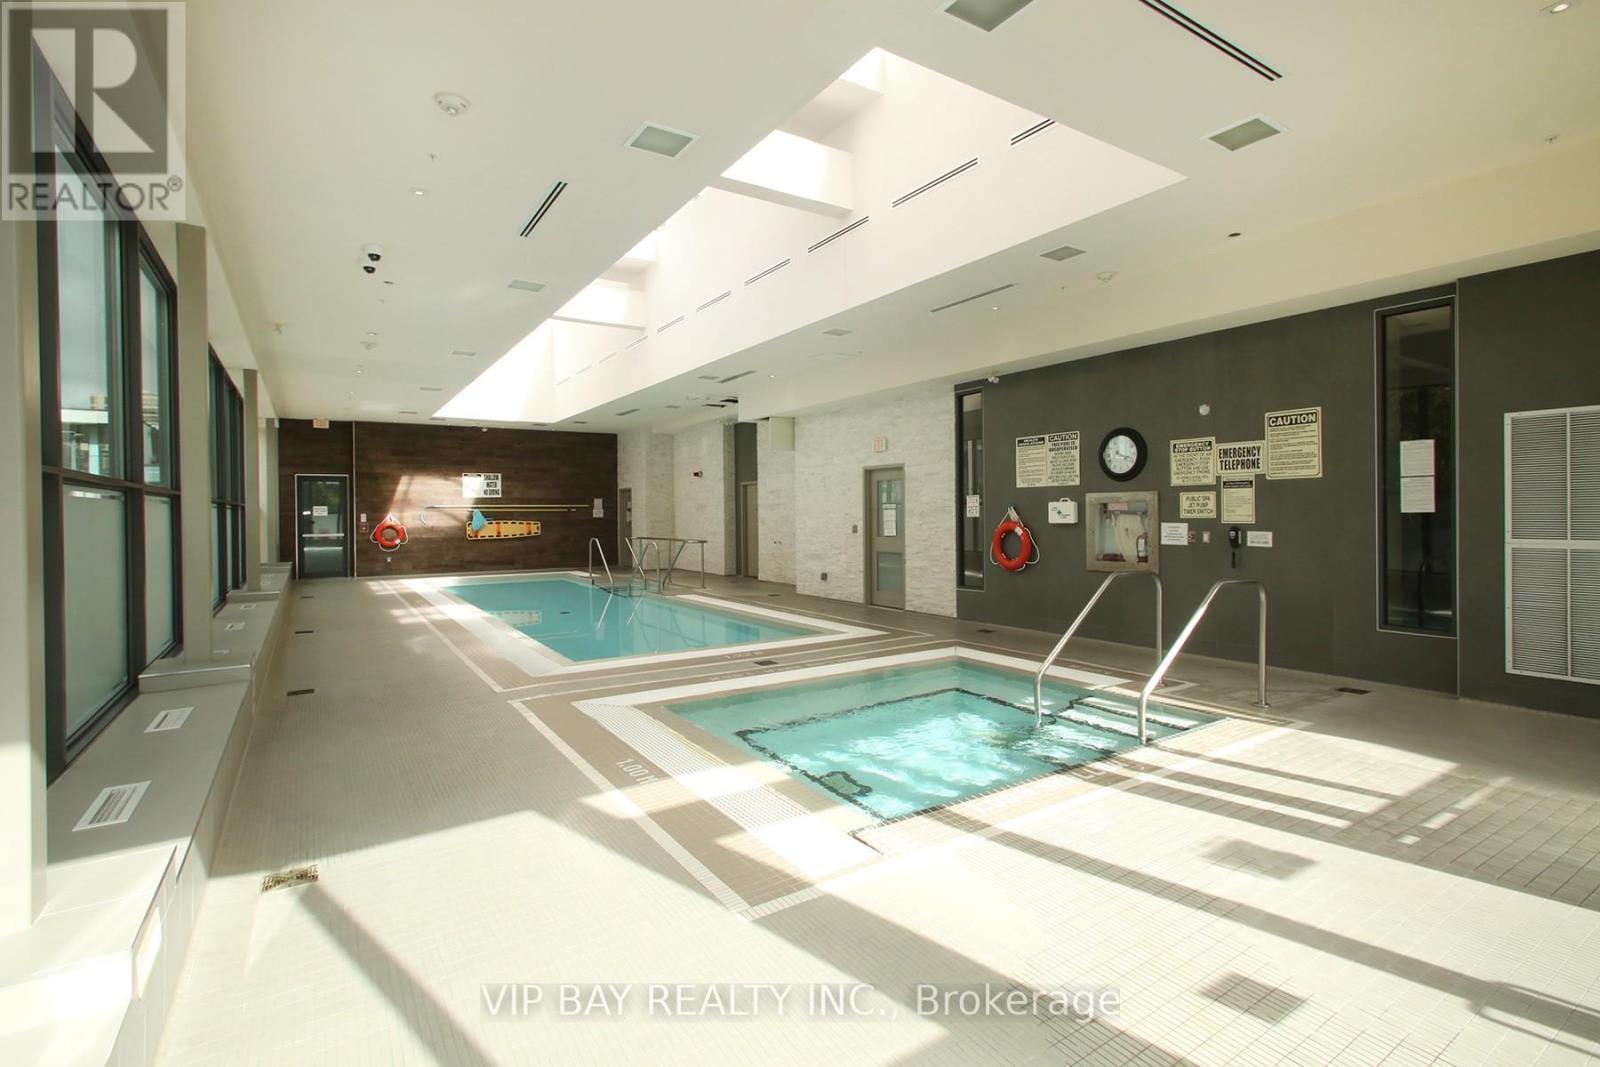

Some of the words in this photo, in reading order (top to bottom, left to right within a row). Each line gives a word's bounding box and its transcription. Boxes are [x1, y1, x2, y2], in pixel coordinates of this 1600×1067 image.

[1269, 413, 1316, 426] CAUTION
[1050, 433, 1078, 442] CAUTION
[1175, 441, 1209, 449] EMERGENCY
[1218, 446, 1261, 459] EMERGENCY
[1219, 458, 1261, 471] TELEPHONE
